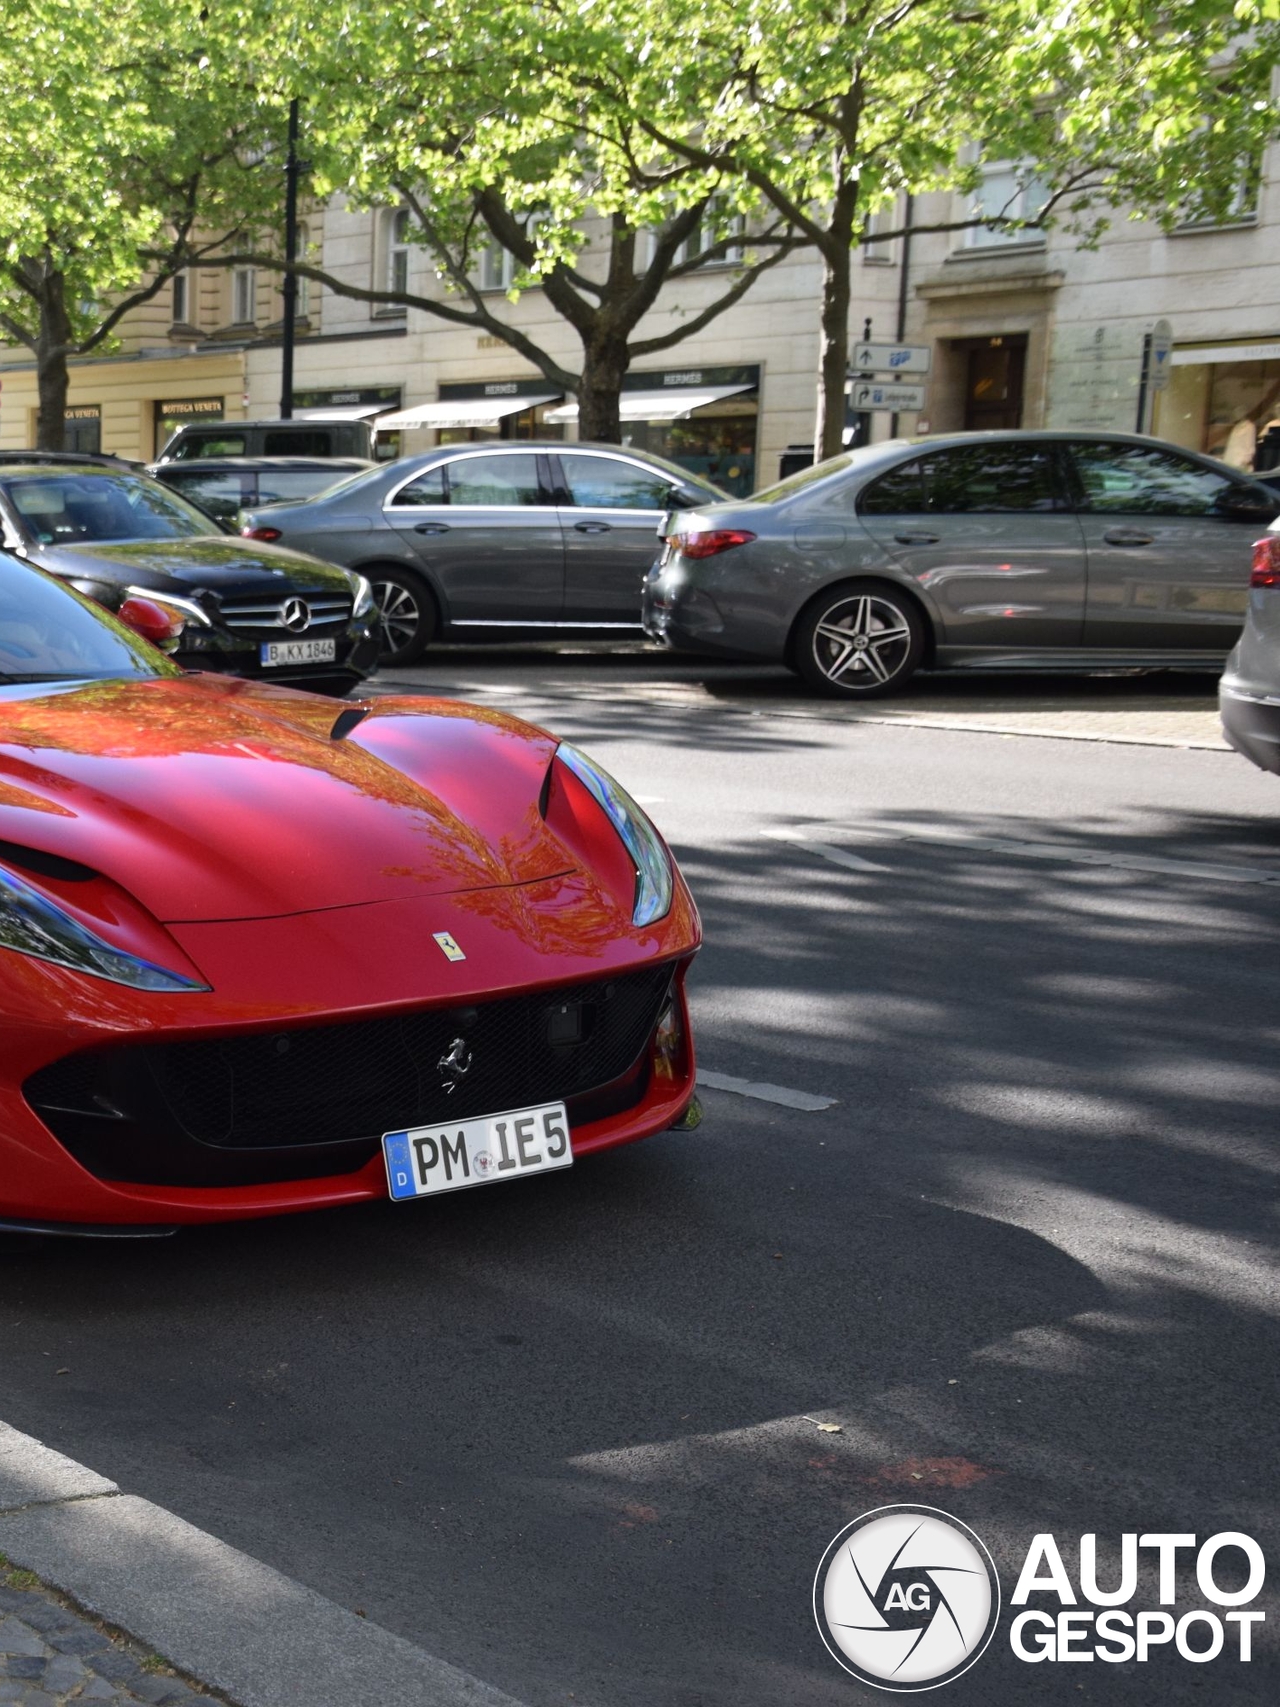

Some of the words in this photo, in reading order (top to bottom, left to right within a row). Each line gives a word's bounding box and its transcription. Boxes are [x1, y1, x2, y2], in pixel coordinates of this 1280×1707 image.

[162, 403, 193, 414] BOTTEGA
[270, 646, 278, 660] B
[412, 1130, 470, 1186] PM
[397, 1172, 407, 1186] D
